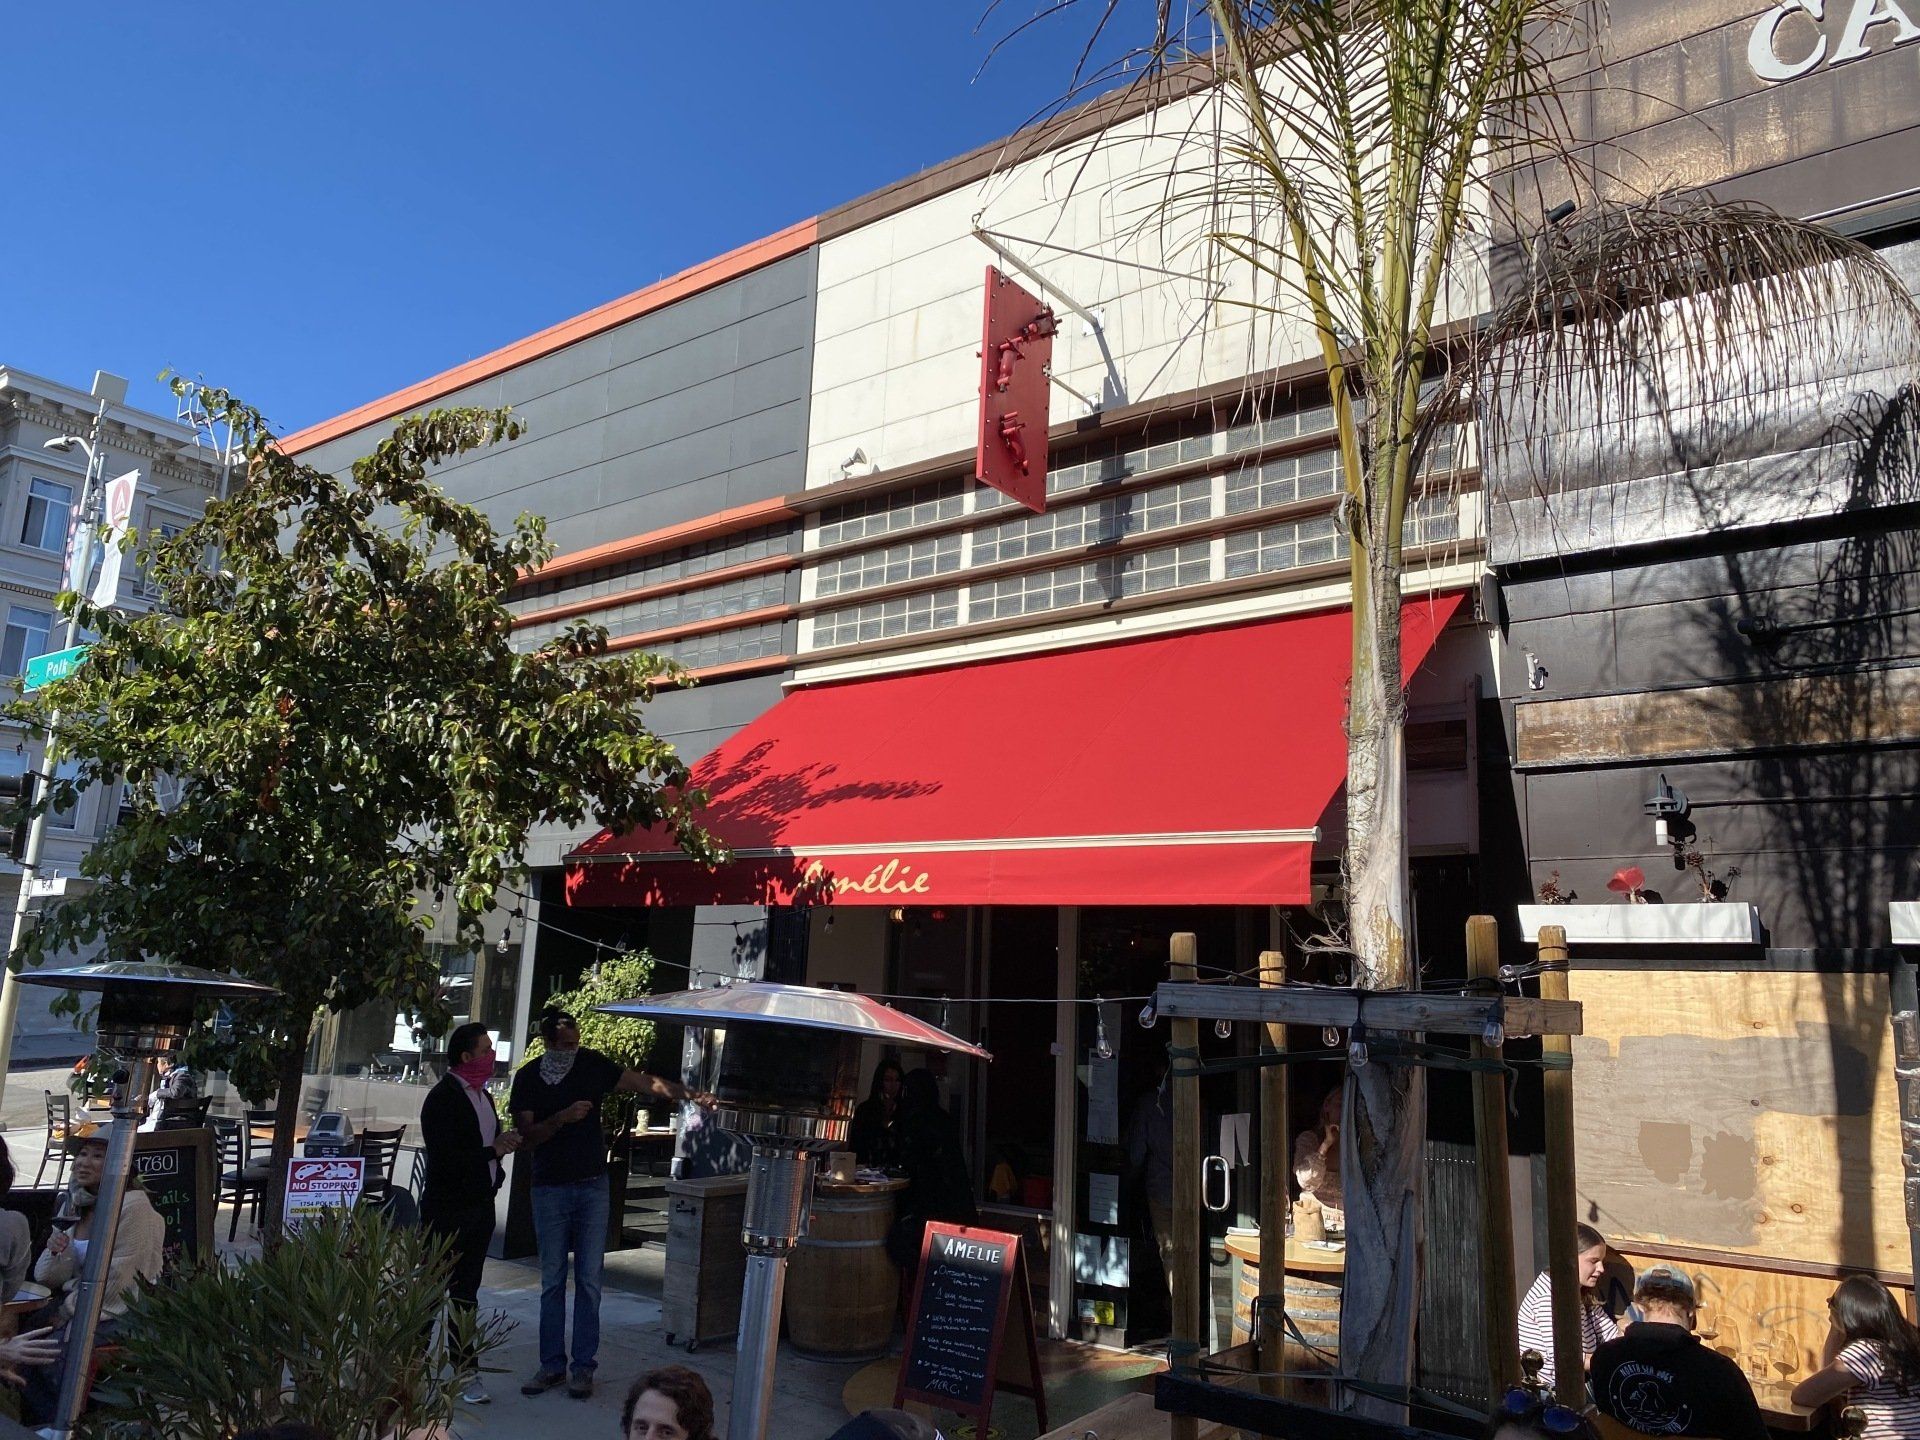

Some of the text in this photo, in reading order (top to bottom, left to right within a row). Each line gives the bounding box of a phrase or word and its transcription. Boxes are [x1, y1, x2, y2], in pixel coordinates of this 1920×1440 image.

[46, 658, 68, 677] Polk
[798, 858, 930, 895] Amélie
[135, 1155, 173, 1171] 1760
[292, 1182, 357, 1190] NO STOPPING
[944, 1238, 1001, 1263] AMELIE
